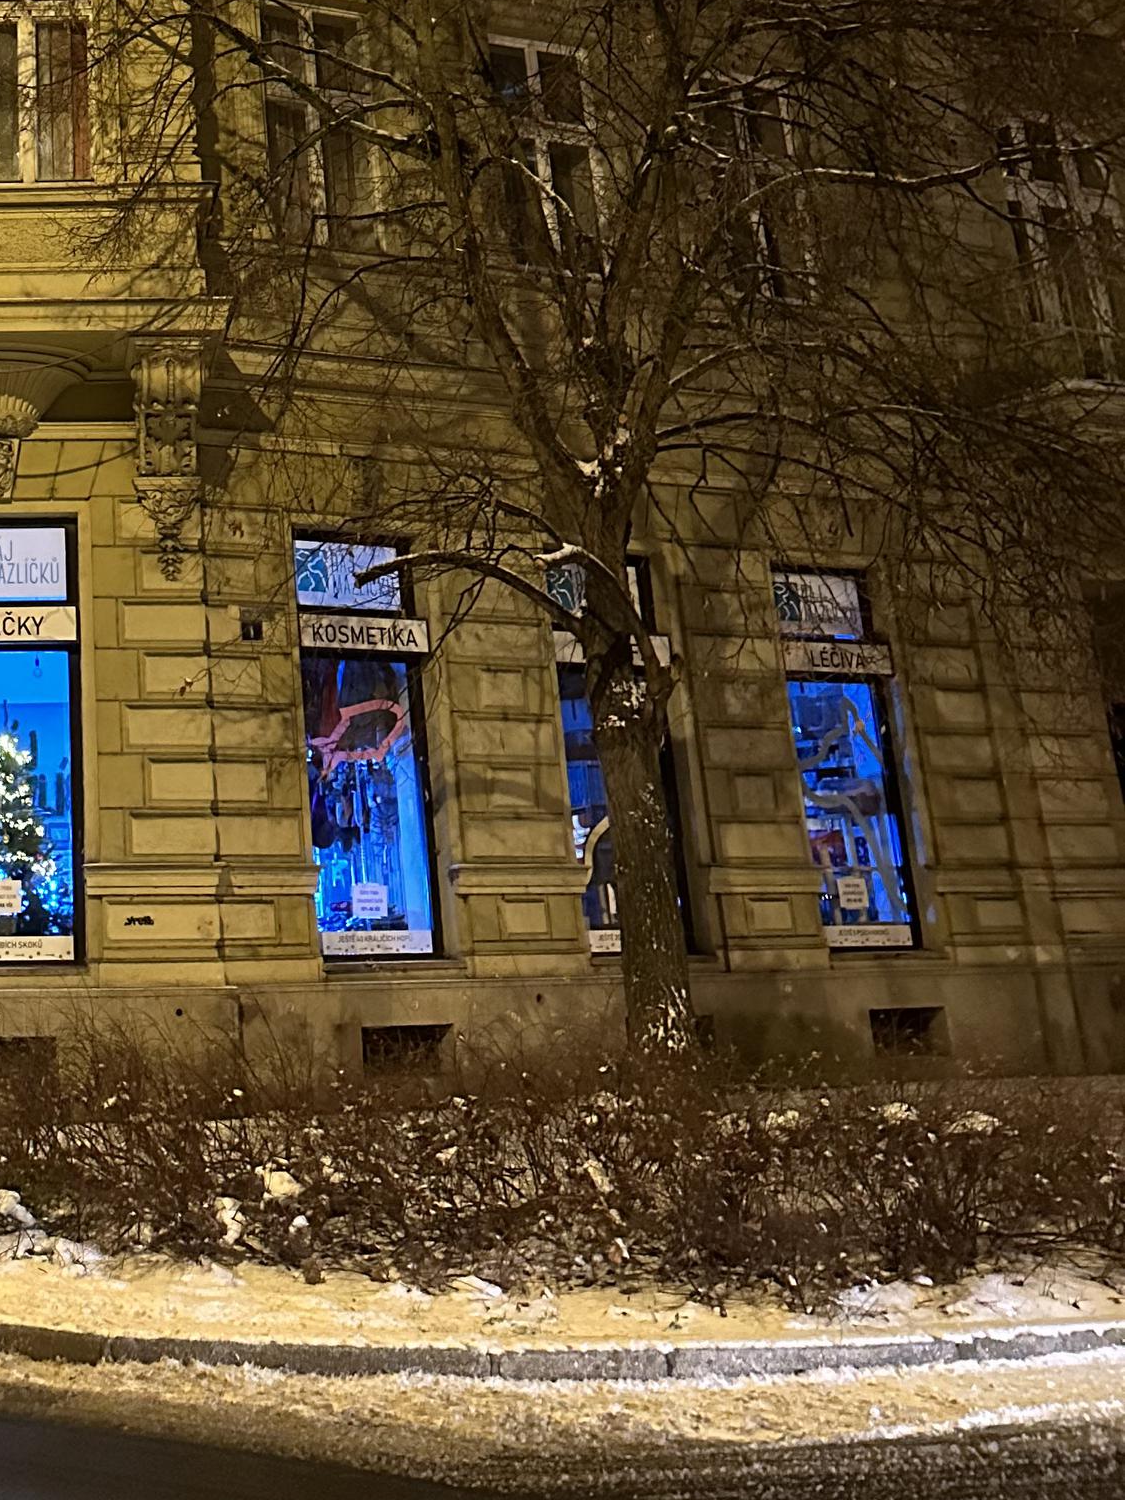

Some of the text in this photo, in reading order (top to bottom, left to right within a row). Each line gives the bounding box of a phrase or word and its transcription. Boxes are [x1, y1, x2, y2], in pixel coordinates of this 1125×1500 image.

[311, 622, 419, 648] KOSMETIKA
[810, 646, 865, 669] LÉČIVA
[18, 938, 43, 949] SKOKŮ
